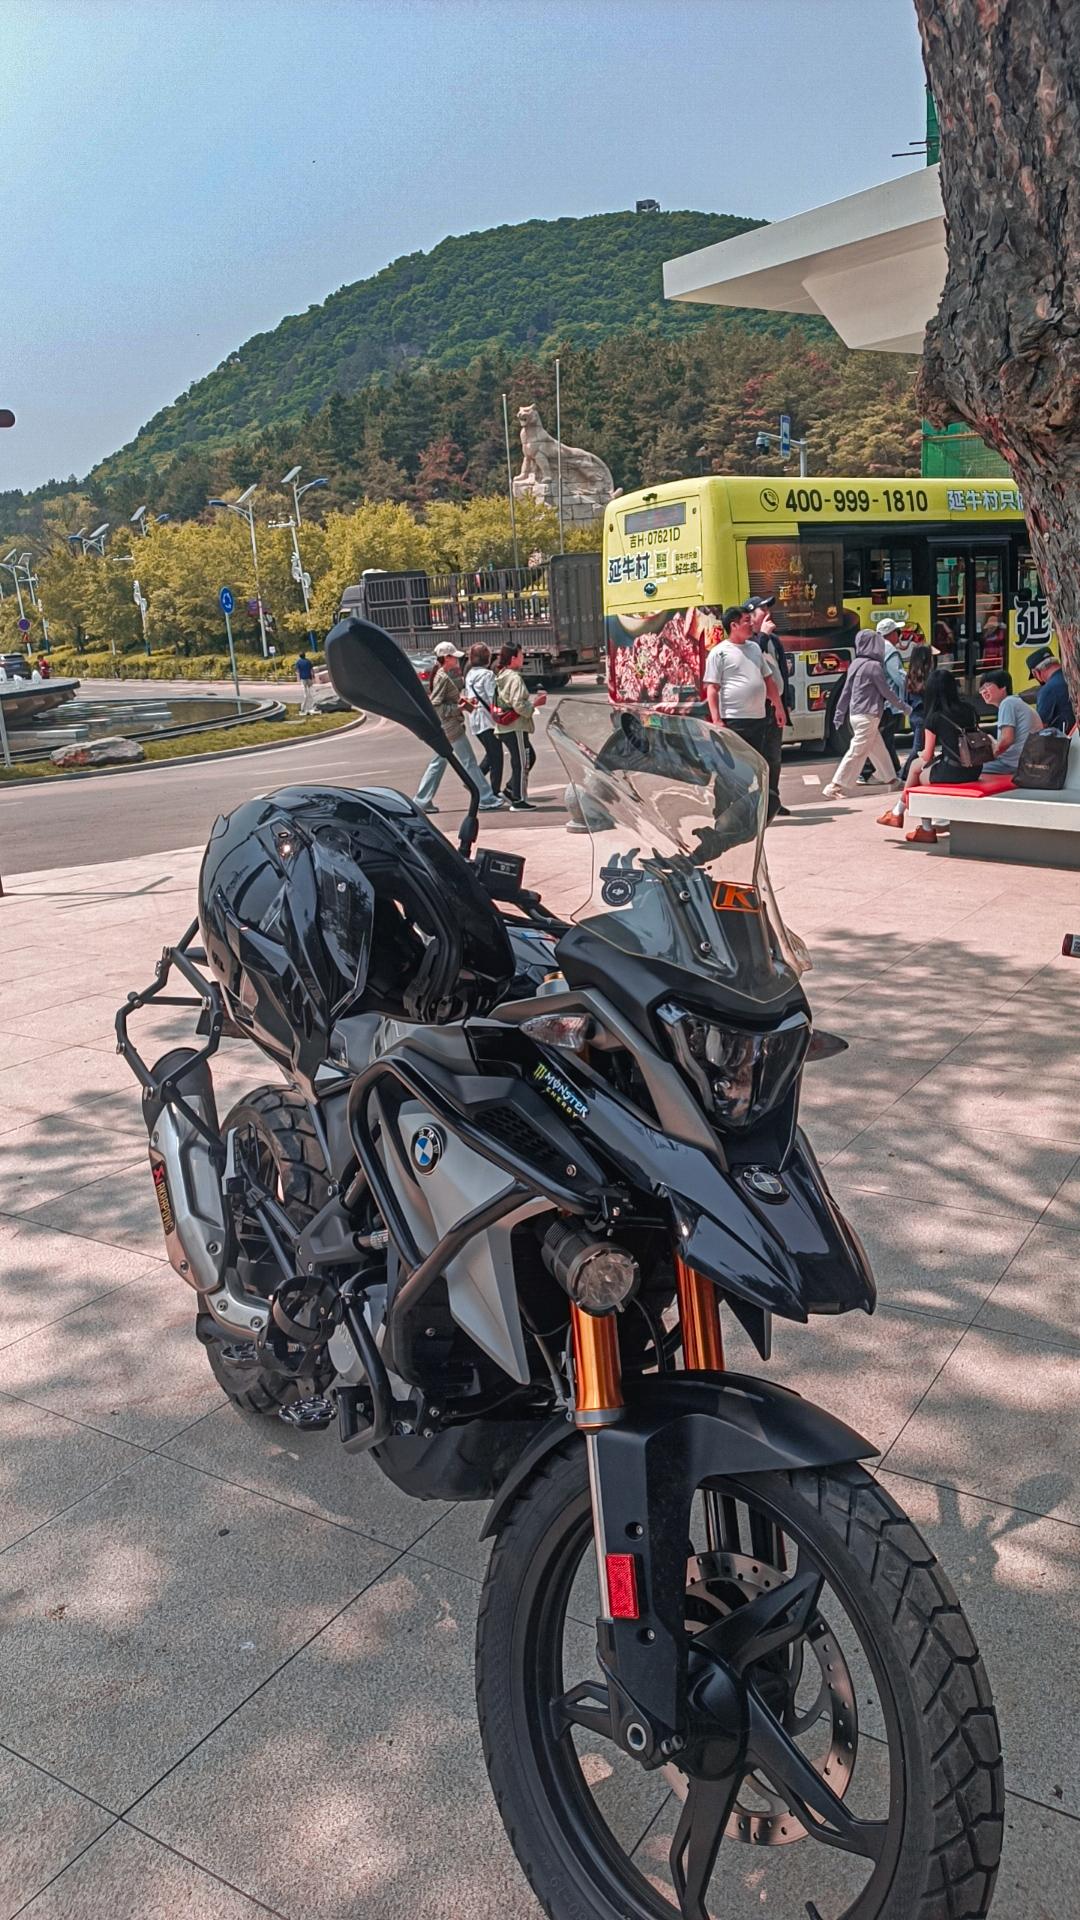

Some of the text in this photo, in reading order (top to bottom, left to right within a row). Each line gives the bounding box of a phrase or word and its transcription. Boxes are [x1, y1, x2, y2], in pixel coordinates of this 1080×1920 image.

[785, 489, 929, 512] 400-999-1810
[608, 552, 650, 583] 延牛村
[545, 1072, 588, 1118] MONSTER
